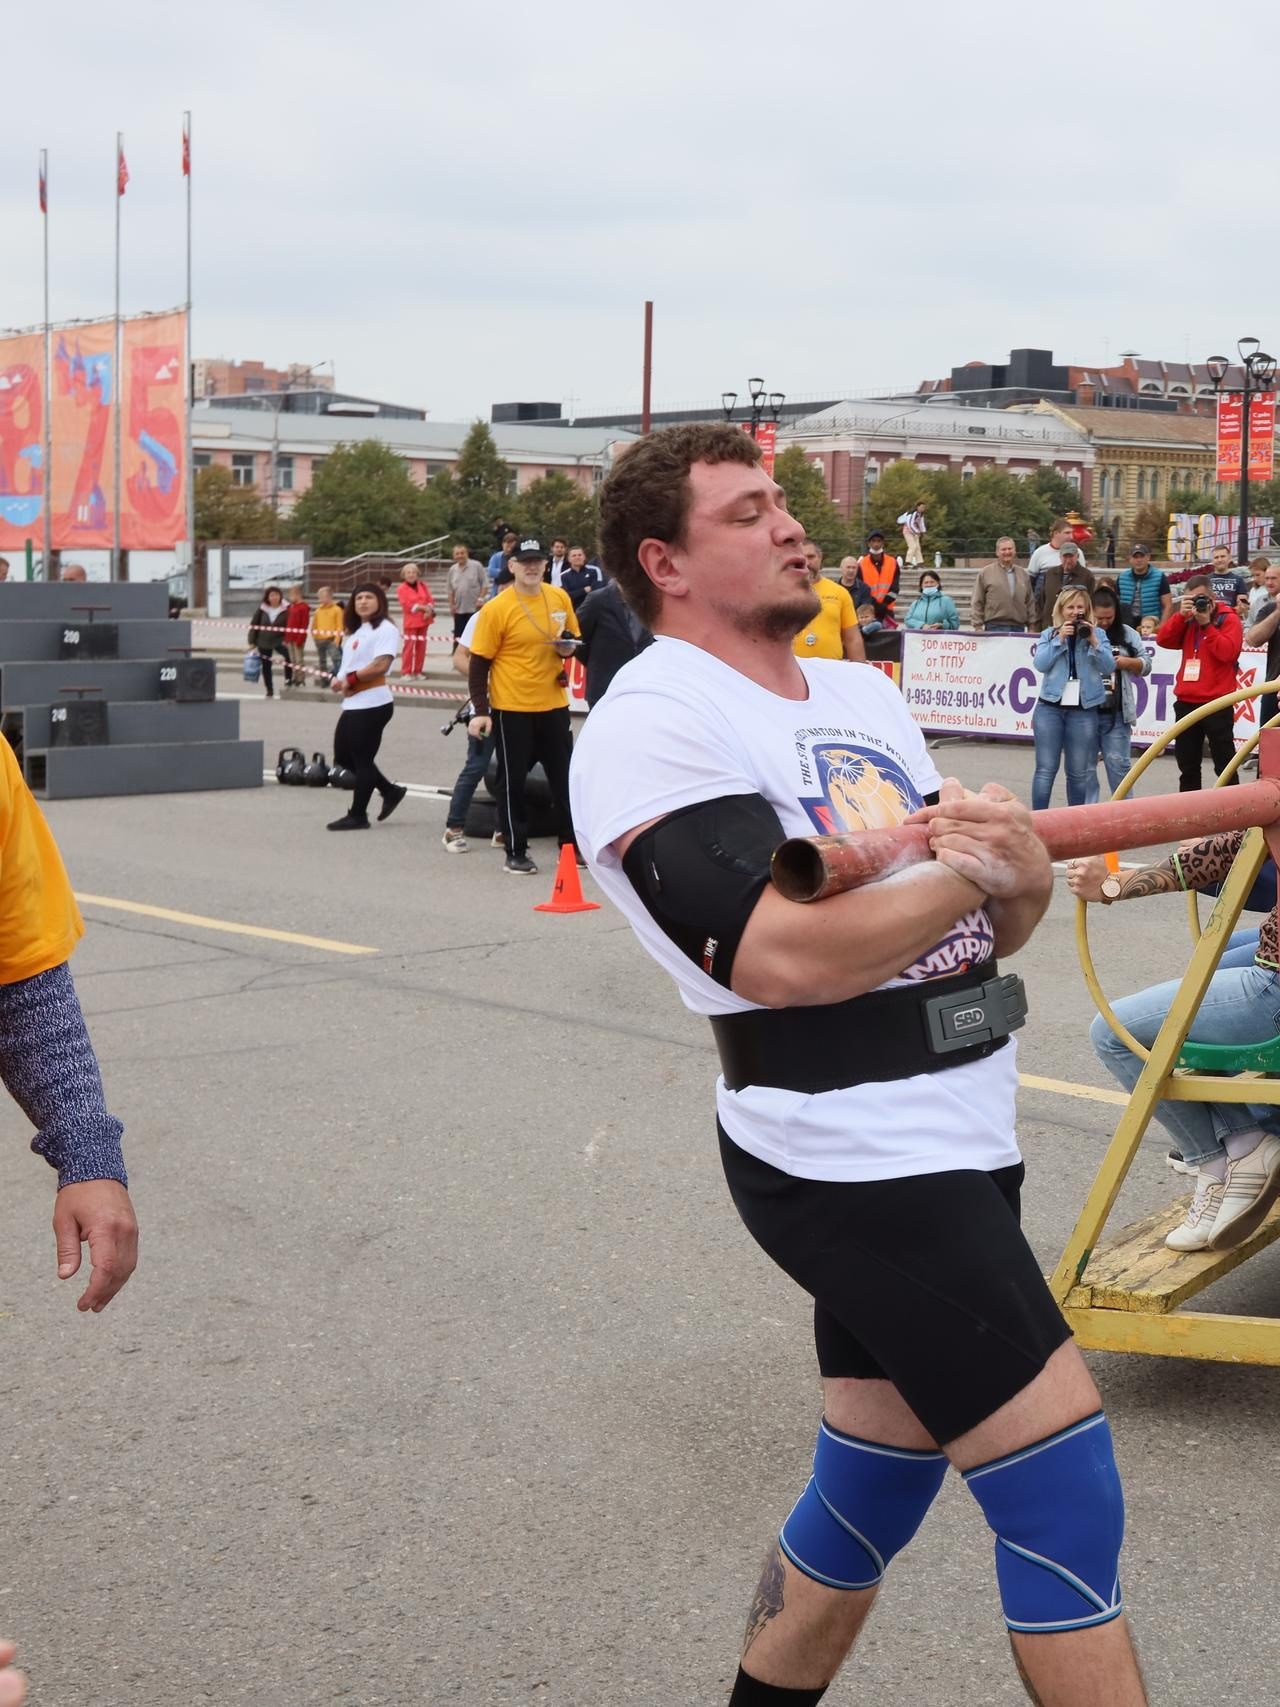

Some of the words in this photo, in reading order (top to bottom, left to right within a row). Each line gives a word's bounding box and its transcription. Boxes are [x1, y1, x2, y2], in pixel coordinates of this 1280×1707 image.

[63, 630, 80, 644] 200
[921, 640, 938, 652] 300
[940, 640, 977, 654] метров
[926, 658, 937, 667] от
[940, 656, 965, 668] ТГПУ
[160, 667, 177, 680] 220
[946, 672, 982, 685] Толстого
[906, 687, 984, 709] 8-953-962-90-04
[52, 708, 67, 722] 240
[911, 710, 997, 727] ww.fitness-tula.ru
[1015, 720, 1028, 731] ул.
[800, 760, 813, 786] THE
[807, 727, 842, 738] NATION
[843, 729, 856, 738] IN
[858, 732, 882, 748] THE
[704, 937, 718, 957] TAPE
[955, 1008, 984, 1029] SBD
